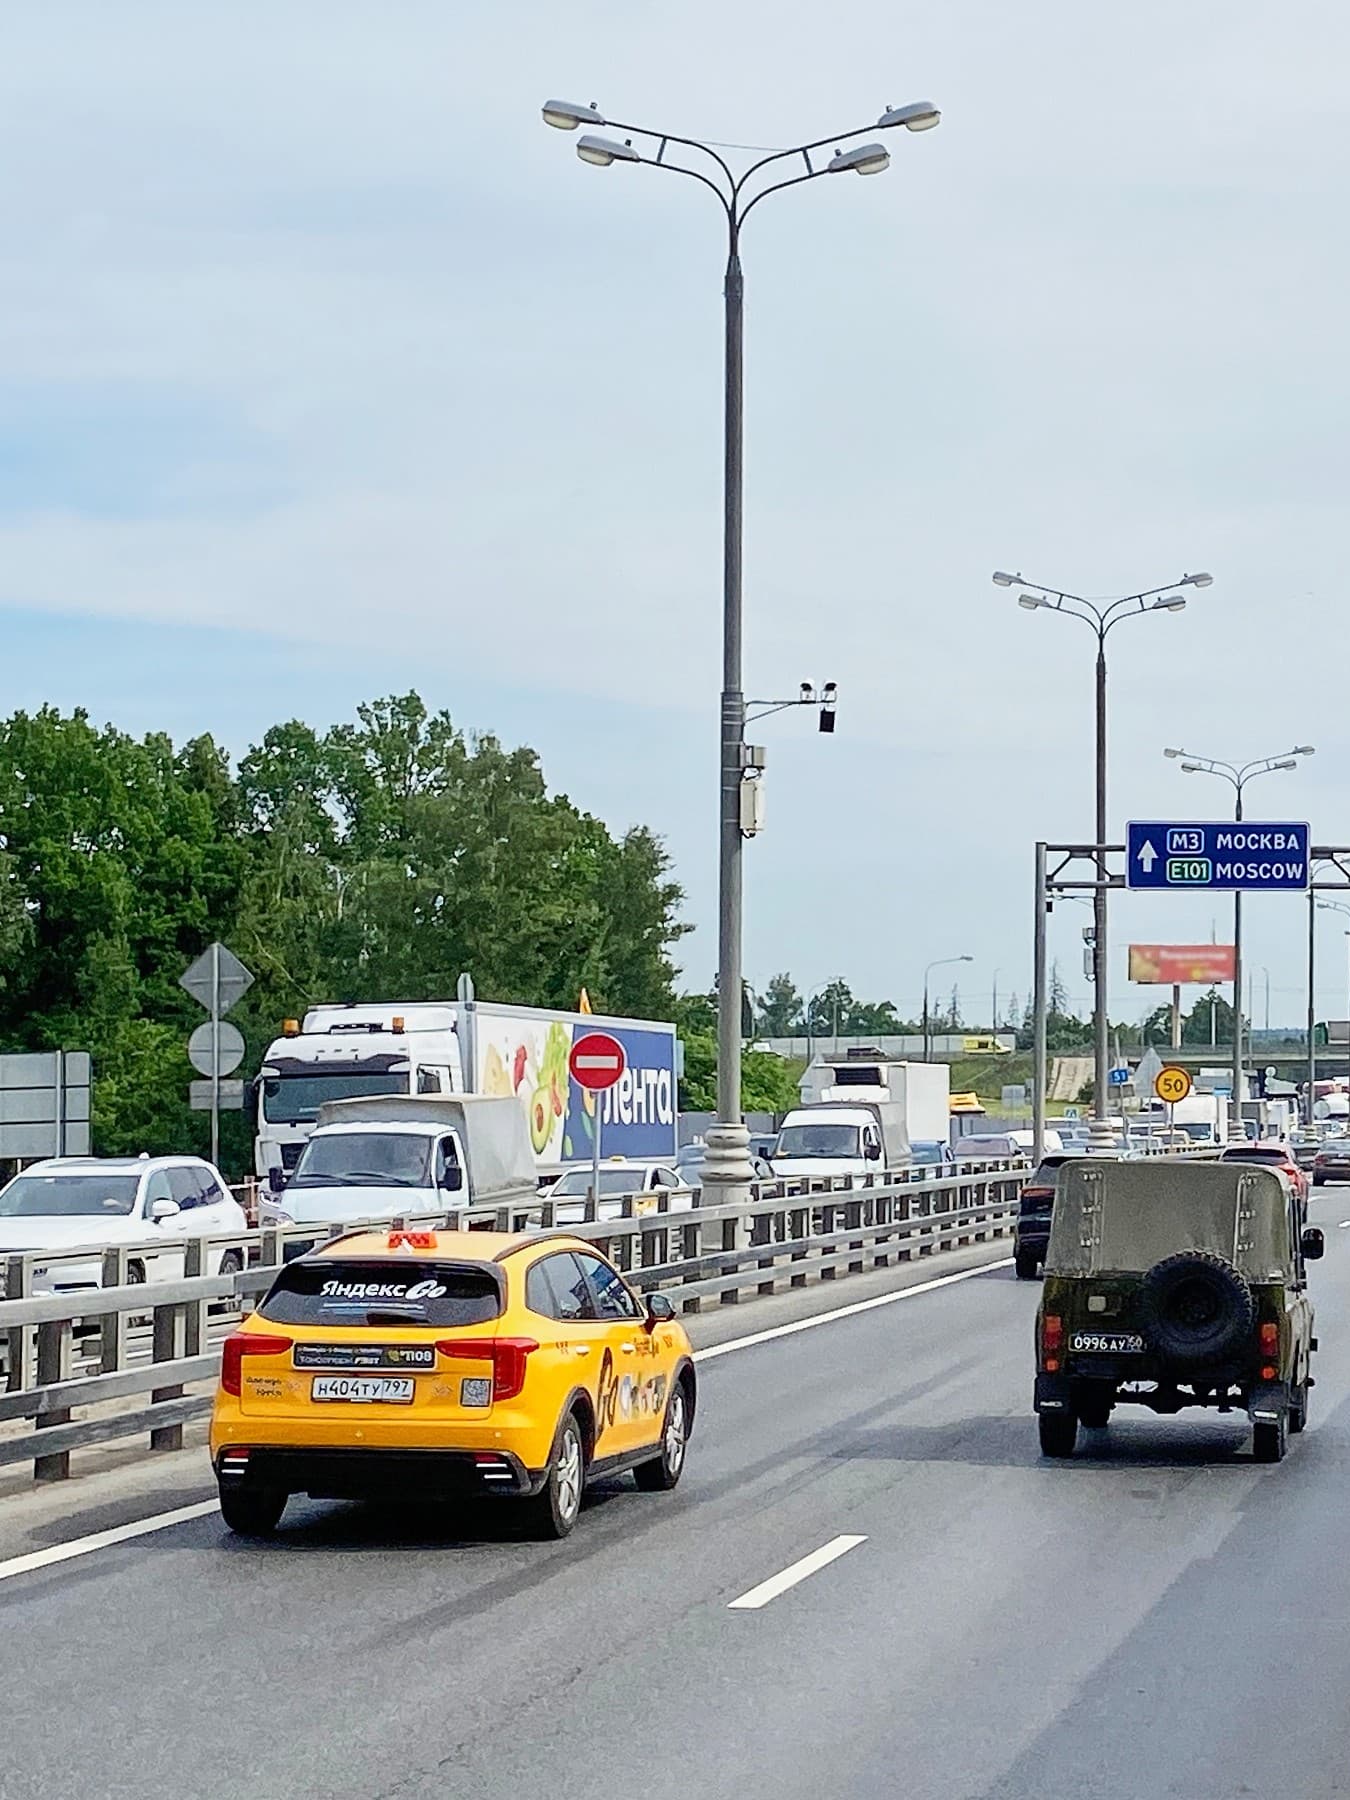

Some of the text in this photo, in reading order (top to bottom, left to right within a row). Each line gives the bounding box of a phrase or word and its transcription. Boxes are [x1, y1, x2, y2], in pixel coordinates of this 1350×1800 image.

[1216, 833, 1300, 850] МОСКВА
[1171, 863, 1303, 880] E101 MOSCOW
[1163, 1077, 1184, 1093] 50
[603, 1068, 673, 1125] лента
[320, 1279, 447, 1300] Яндекс Go
